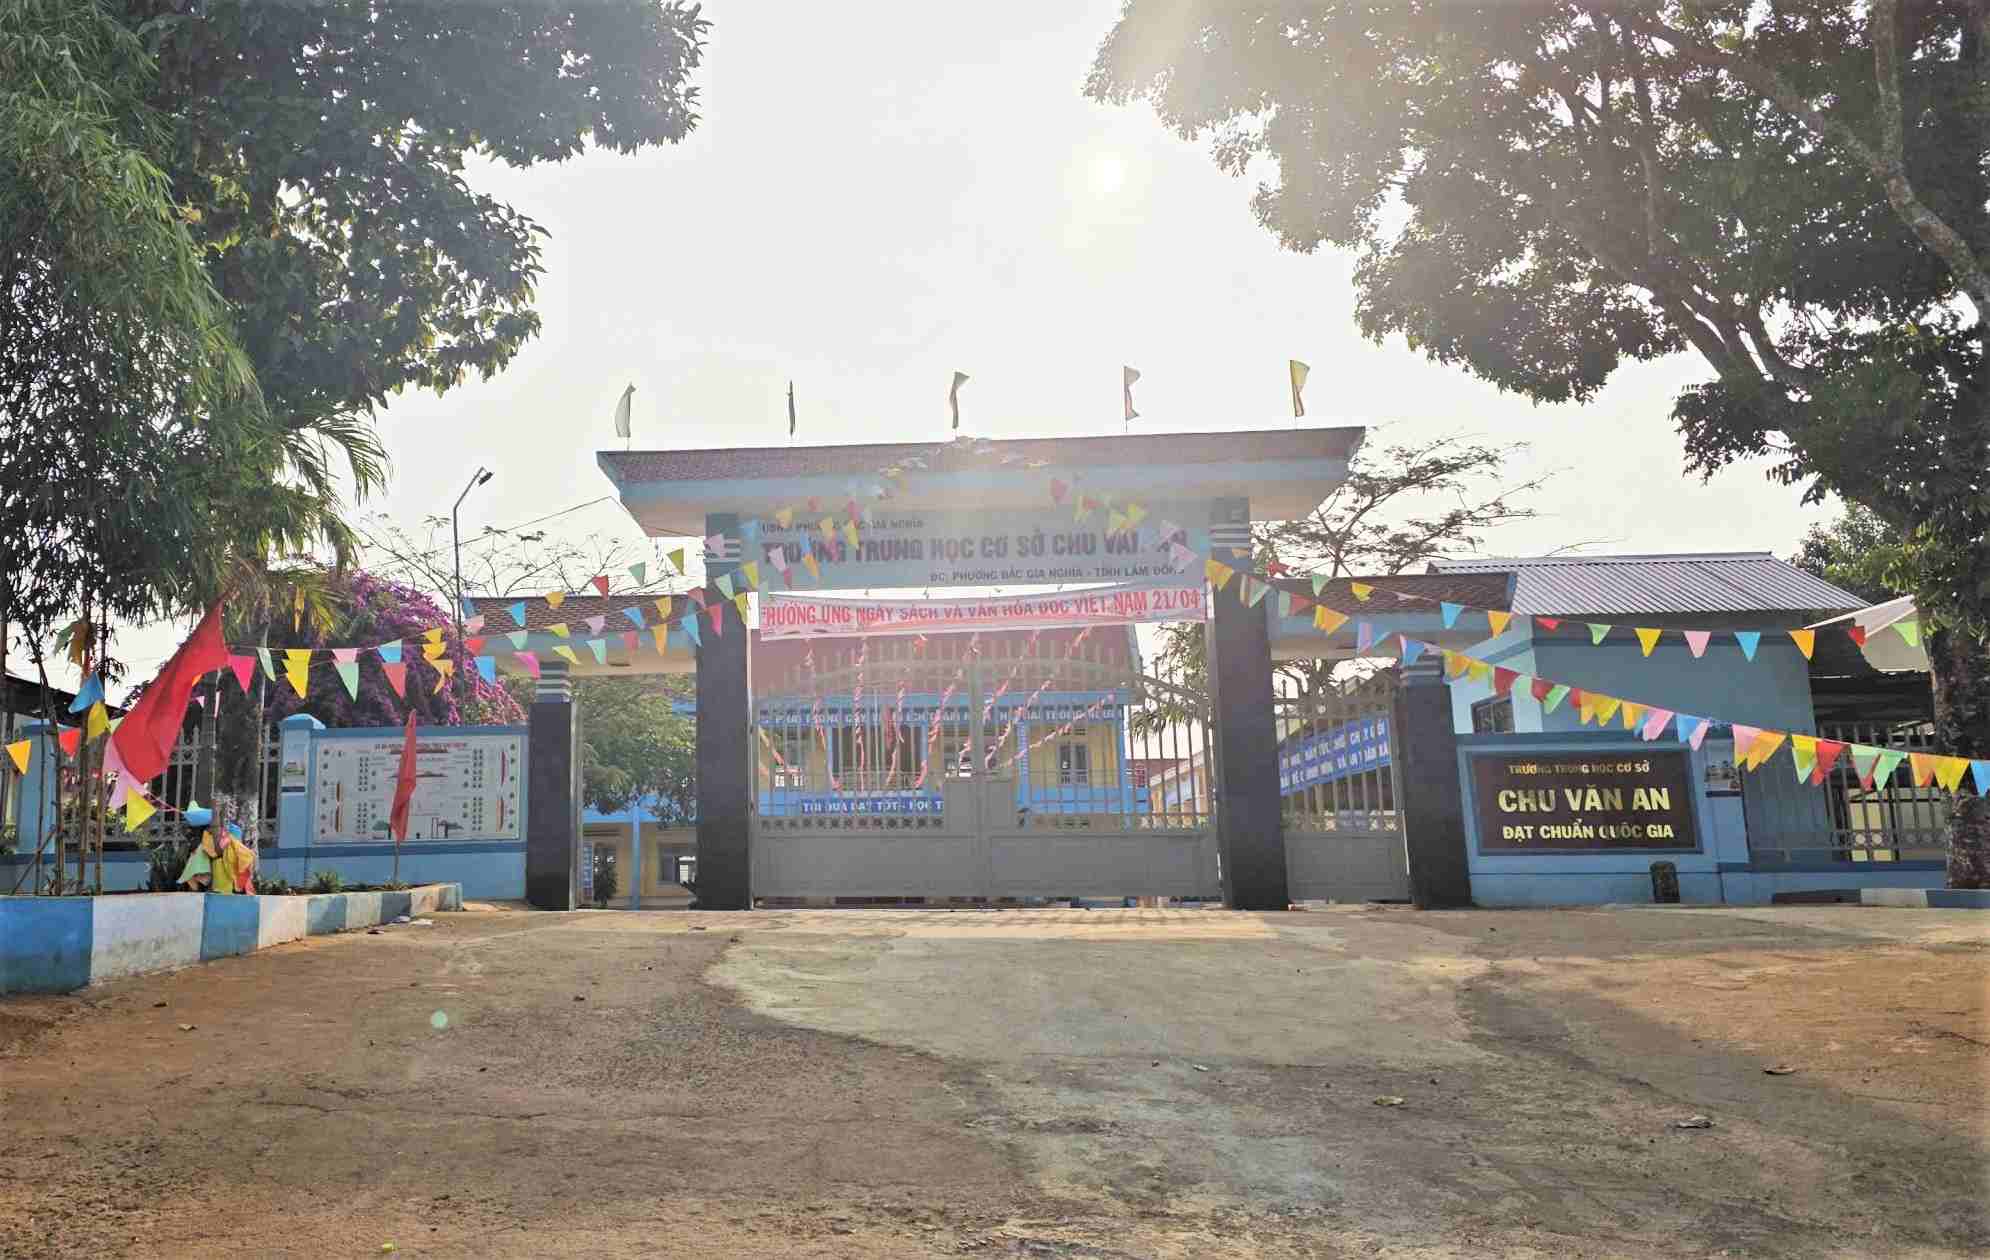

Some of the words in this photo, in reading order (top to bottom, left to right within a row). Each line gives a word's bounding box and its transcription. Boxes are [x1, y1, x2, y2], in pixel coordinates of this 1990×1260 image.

[1053, 531, 1097, 556] CHU
[900, 602, 938, 621] SÁCH
[943, 602, 964, 620] VÀ
[1152, 588, 1200, 610] 21/04
[1616, 761, 1633, 774] CƠ
[1633, 758, 1650, 774] SỞ
[1499, 787, 1556, 813] CHU
[1564, 783, 1624, 812] VĂN
[1632, 786, 1671, 811] AN
[1502, 825, 1535, 843] ĐẠT
[1539, 818, 1595, 841] CHUẨN
[1646, 823, 1674, 839] GIA
